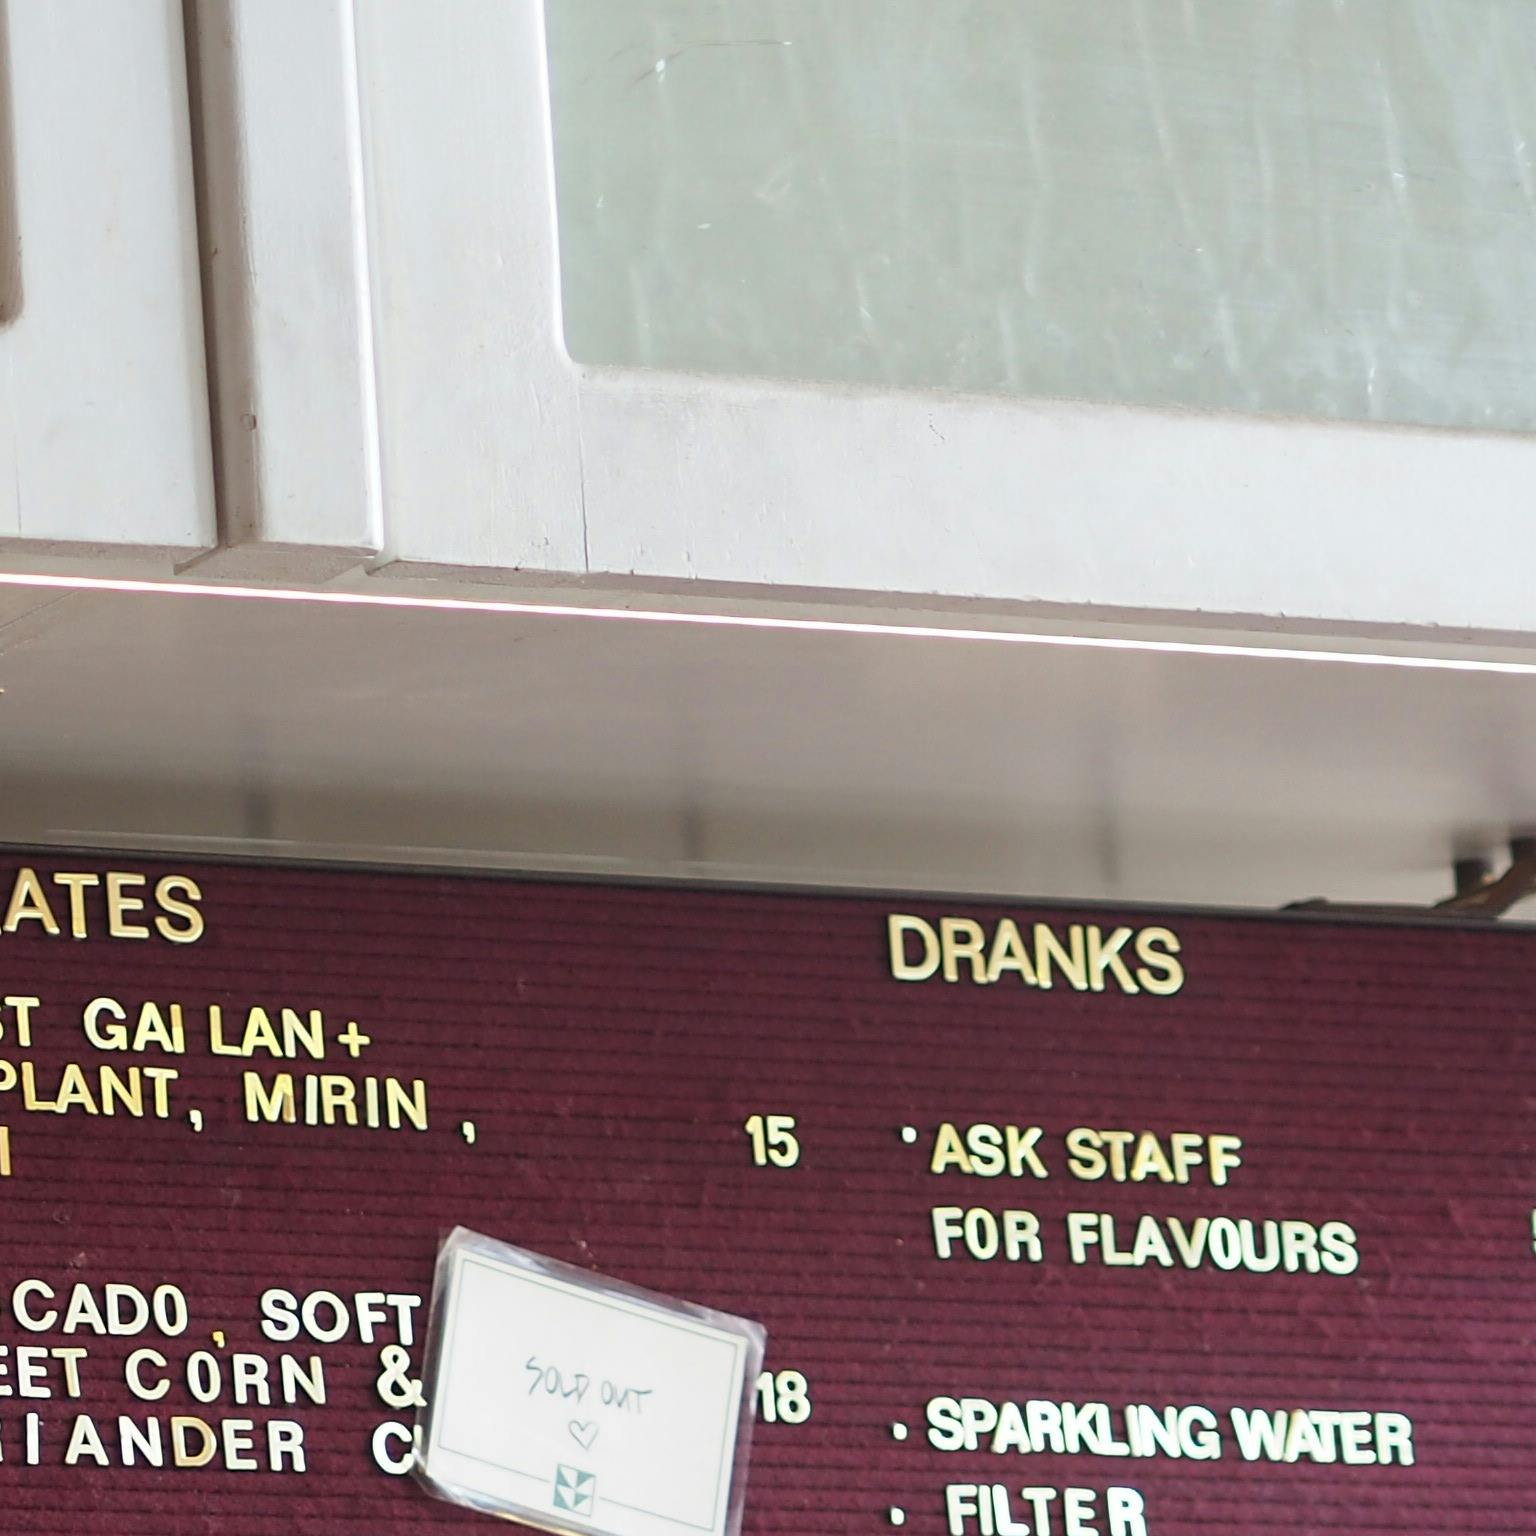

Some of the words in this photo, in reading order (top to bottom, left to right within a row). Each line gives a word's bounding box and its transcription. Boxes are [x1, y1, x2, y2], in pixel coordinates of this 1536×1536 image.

[889, 915, 1184, 994] DRANKS
[84, 998, 184, 1053] GAI
[746, 1116, 799, 1167] 15
[932, 1124, 1048, 1178] ASK
[1067, 1128, 1241, 1185] STAFF
[933, 1207, 1042, 1261] FOR
[1068, 1213, 1358, 1274] FLAVOURS
[261, 1289, 421, 1345] SOFT
[126, 1349, 326, 1405] CORN
[377, 1345, 427, 1409] &
[756, 1369, 812, 1424] 18
[927, 1397, 1221, 1459] SPARKLING
[1231, 1408, 1414, 1465] WATER
